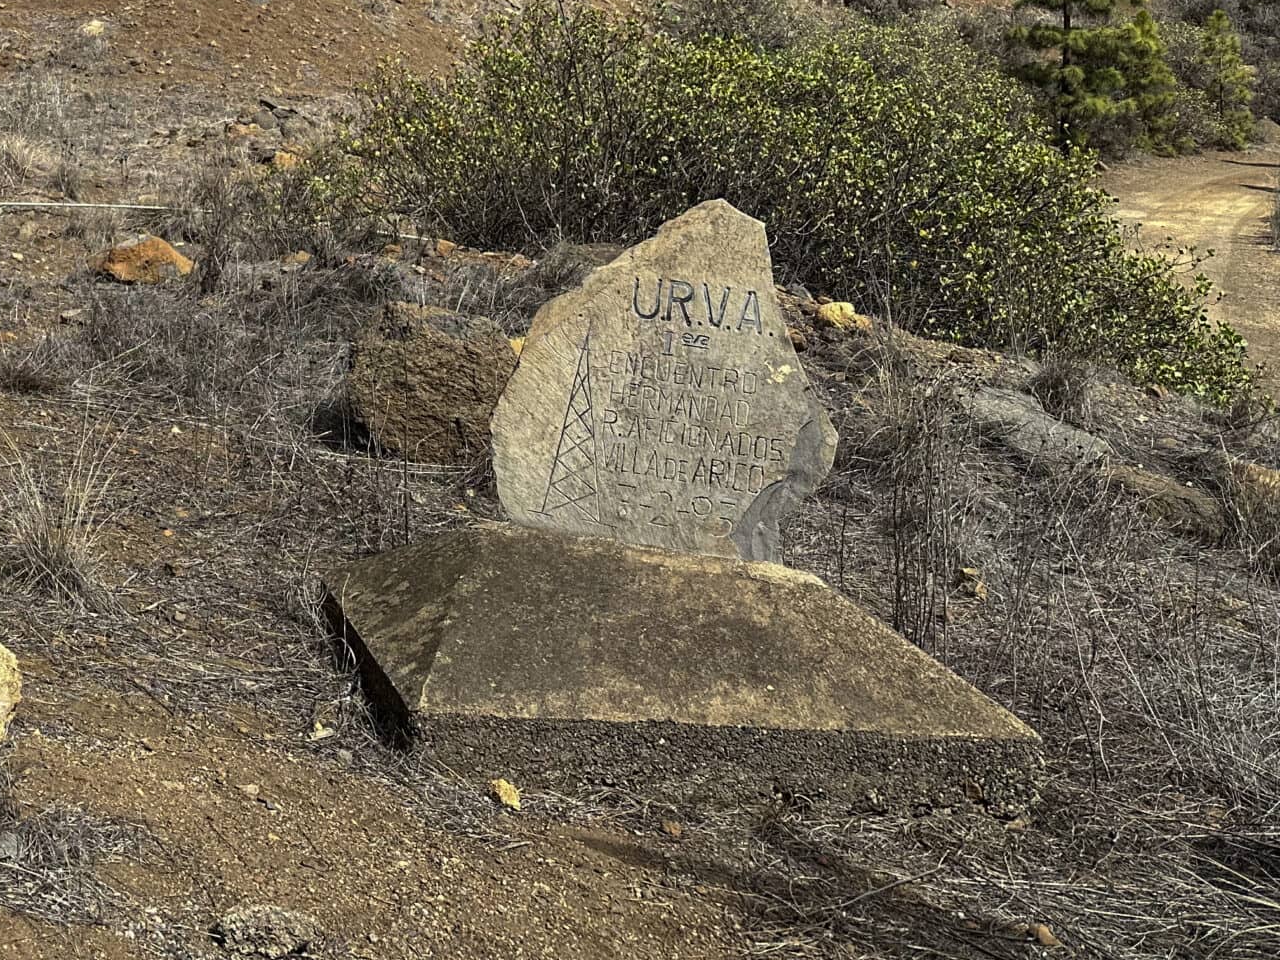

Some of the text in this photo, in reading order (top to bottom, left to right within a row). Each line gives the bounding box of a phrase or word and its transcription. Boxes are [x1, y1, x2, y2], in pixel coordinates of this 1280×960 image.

[609, 350, 757, 394] ENCUENTRO
[610, 381, 751, 427] HERMANDAD
[603, 442, 765, 494] VILLA DE ARICO
